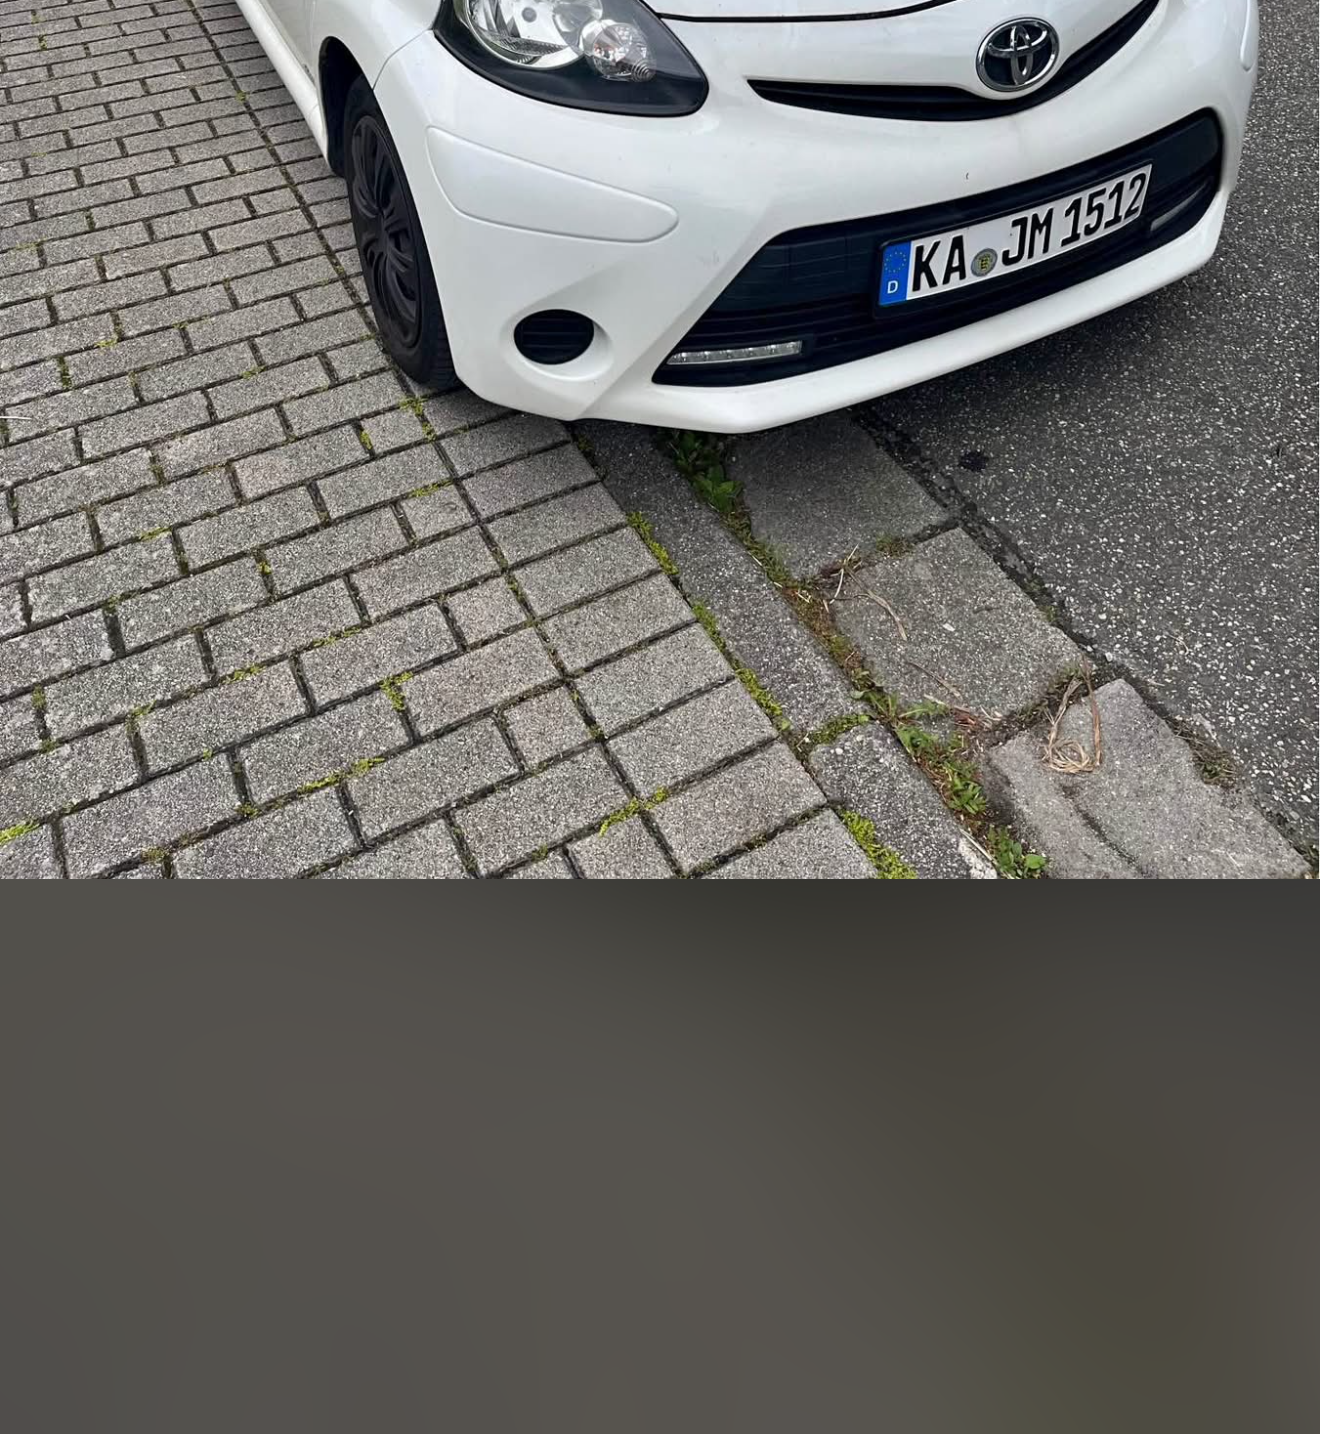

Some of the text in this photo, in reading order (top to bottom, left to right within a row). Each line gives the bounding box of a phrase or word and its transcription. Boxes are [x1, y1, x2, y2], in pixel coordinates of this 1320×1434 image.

[911, 172, 1148, 293] KA JM 1512
[886, 280, 900, 295] D
